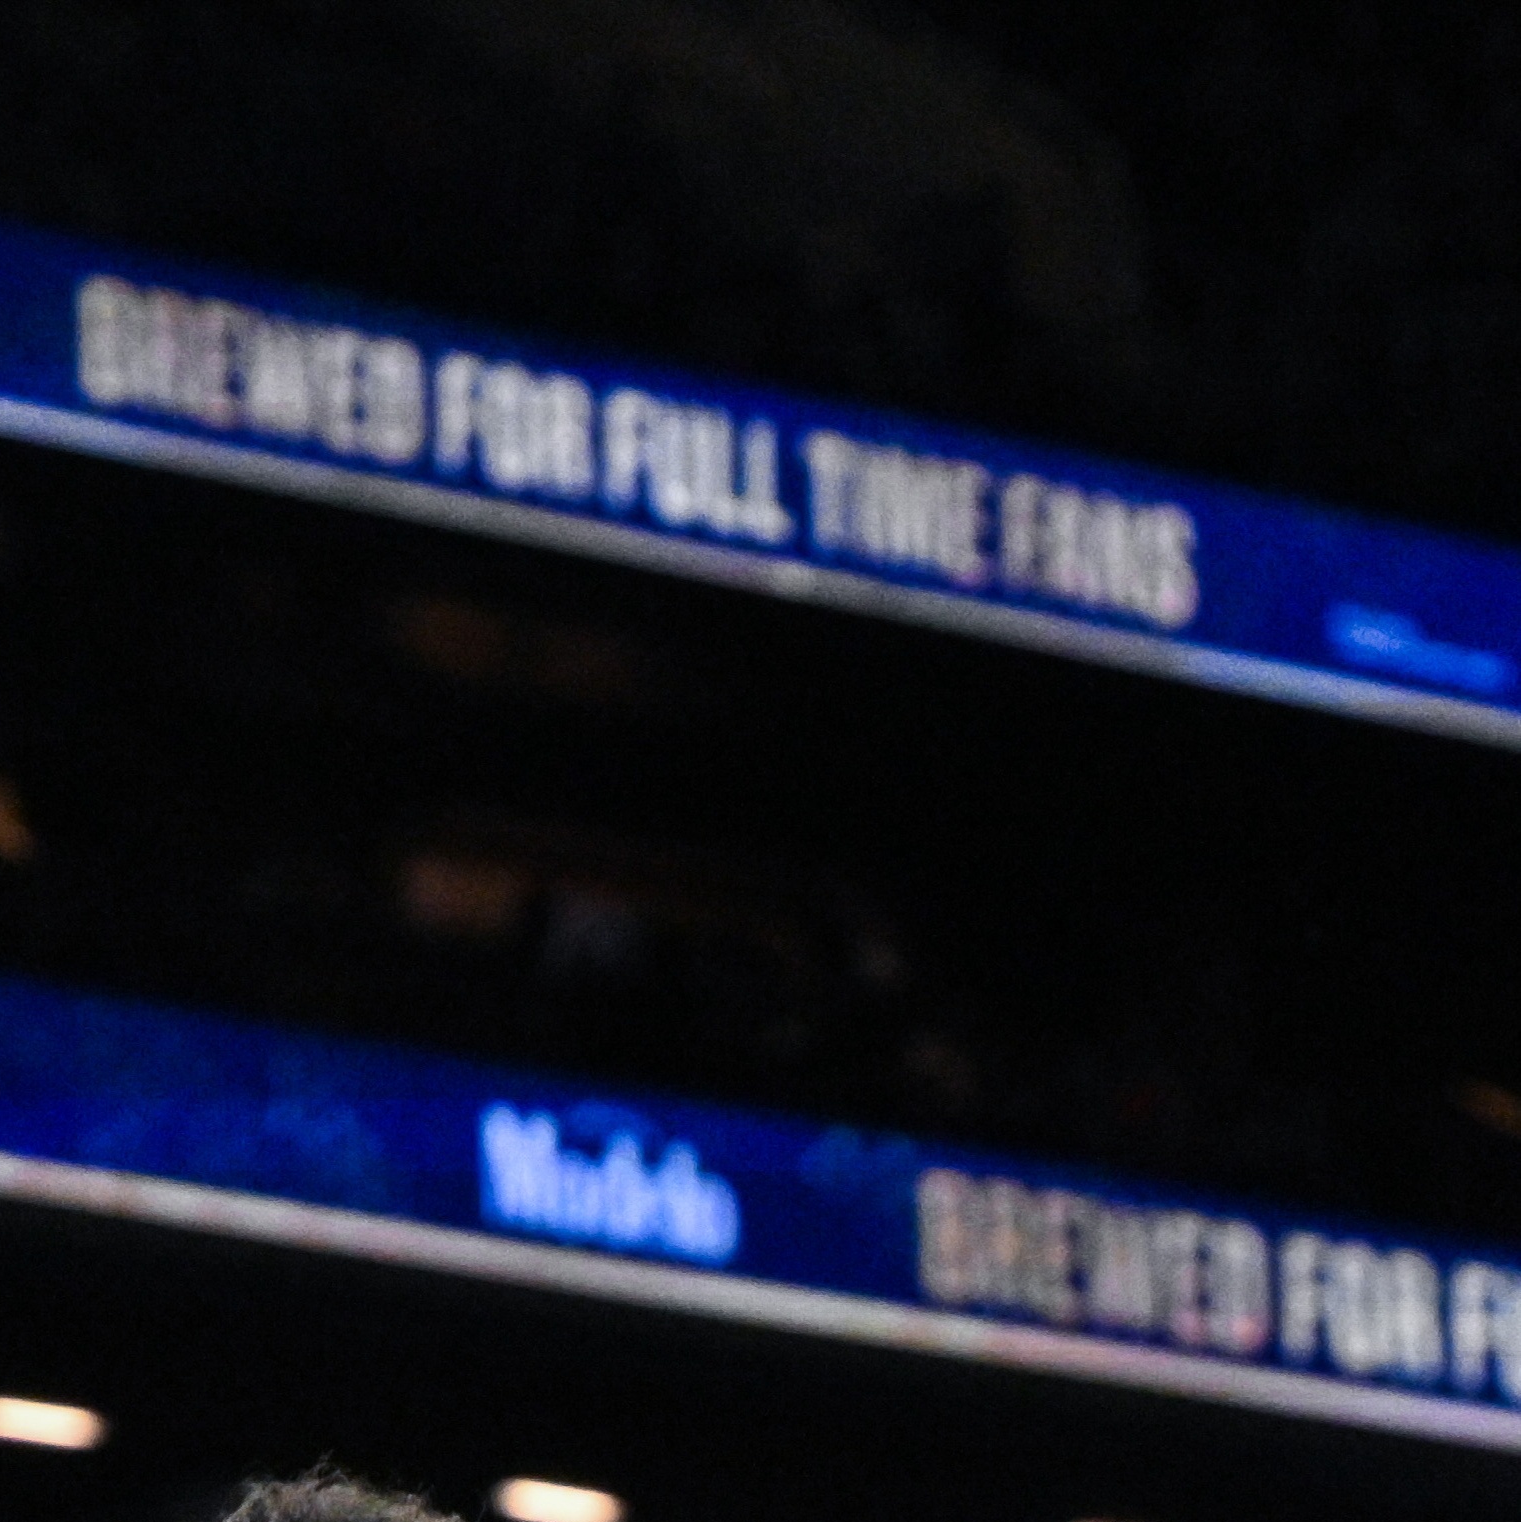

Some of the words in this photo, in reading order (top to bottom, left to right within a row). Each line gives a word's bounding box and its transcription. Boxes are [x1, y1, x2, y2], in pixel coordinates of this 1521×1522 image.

[433, 350, 594, 497] FOR
[603, 386, 793, 545] FULL
[802, 430, 989, 585] TIME
[999, 473, 1197, 632] FANS
[1279, 1229, 1443, 1378] FOR
